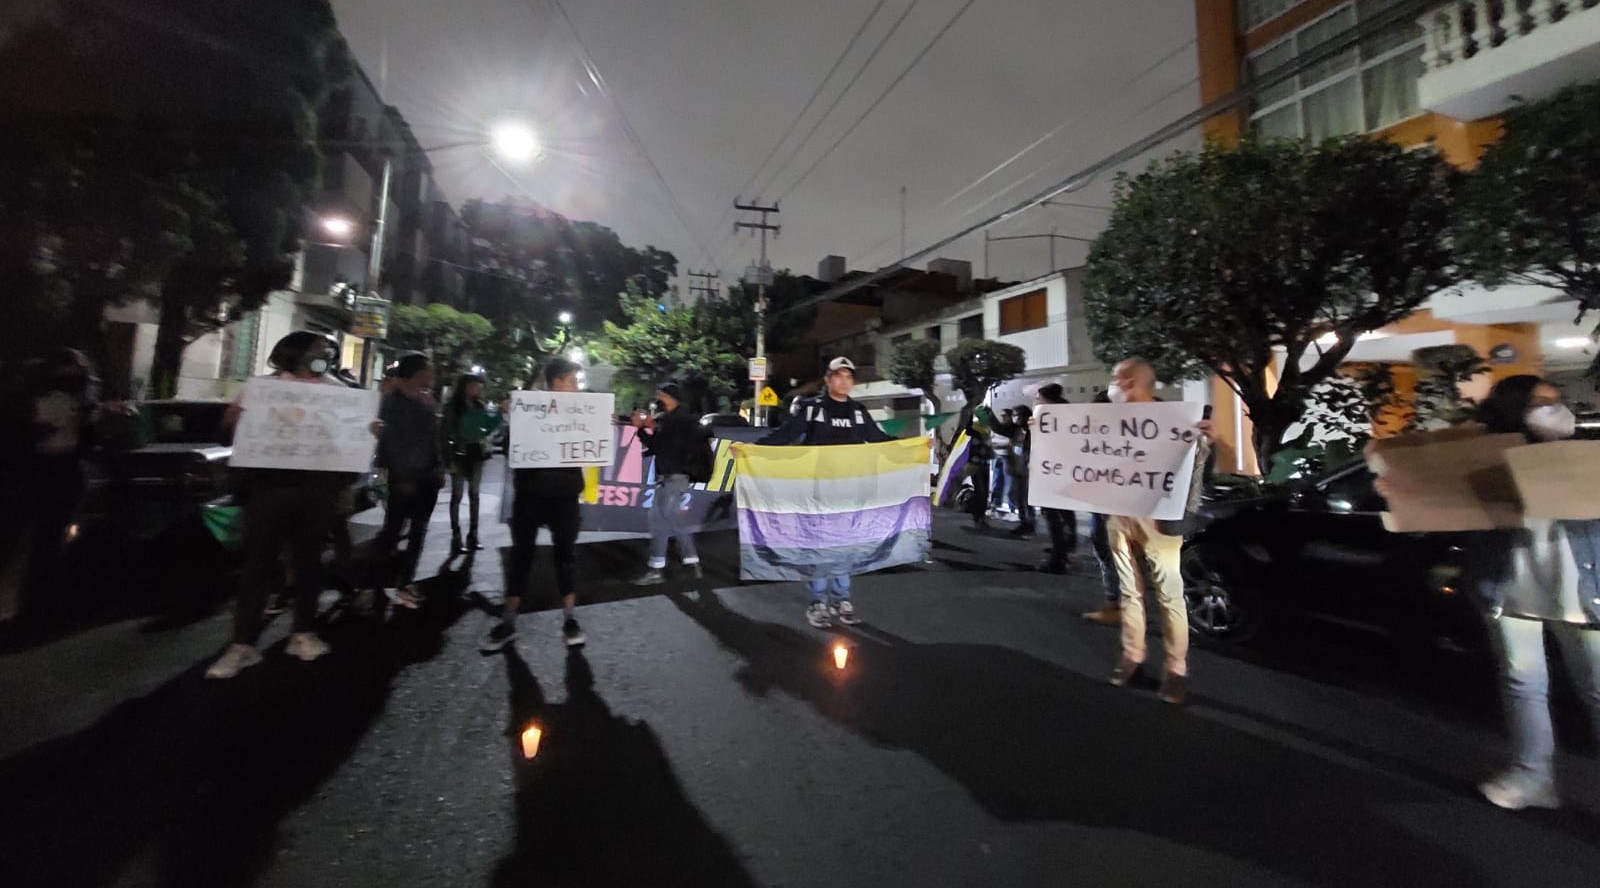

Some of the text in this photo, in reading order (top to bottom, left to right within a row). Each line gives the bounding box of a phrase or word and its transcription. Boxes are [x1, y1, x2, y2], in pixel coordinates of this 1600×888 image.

[512, 398, 558, 419] AmigA
[1040, 412, 1193, 443] El odio NO se
[511, 440, 608, 463] Eres TERF
[1080, 439, 1146, 462] debate
[1042, 461, 1175, 492] se COMBATE
